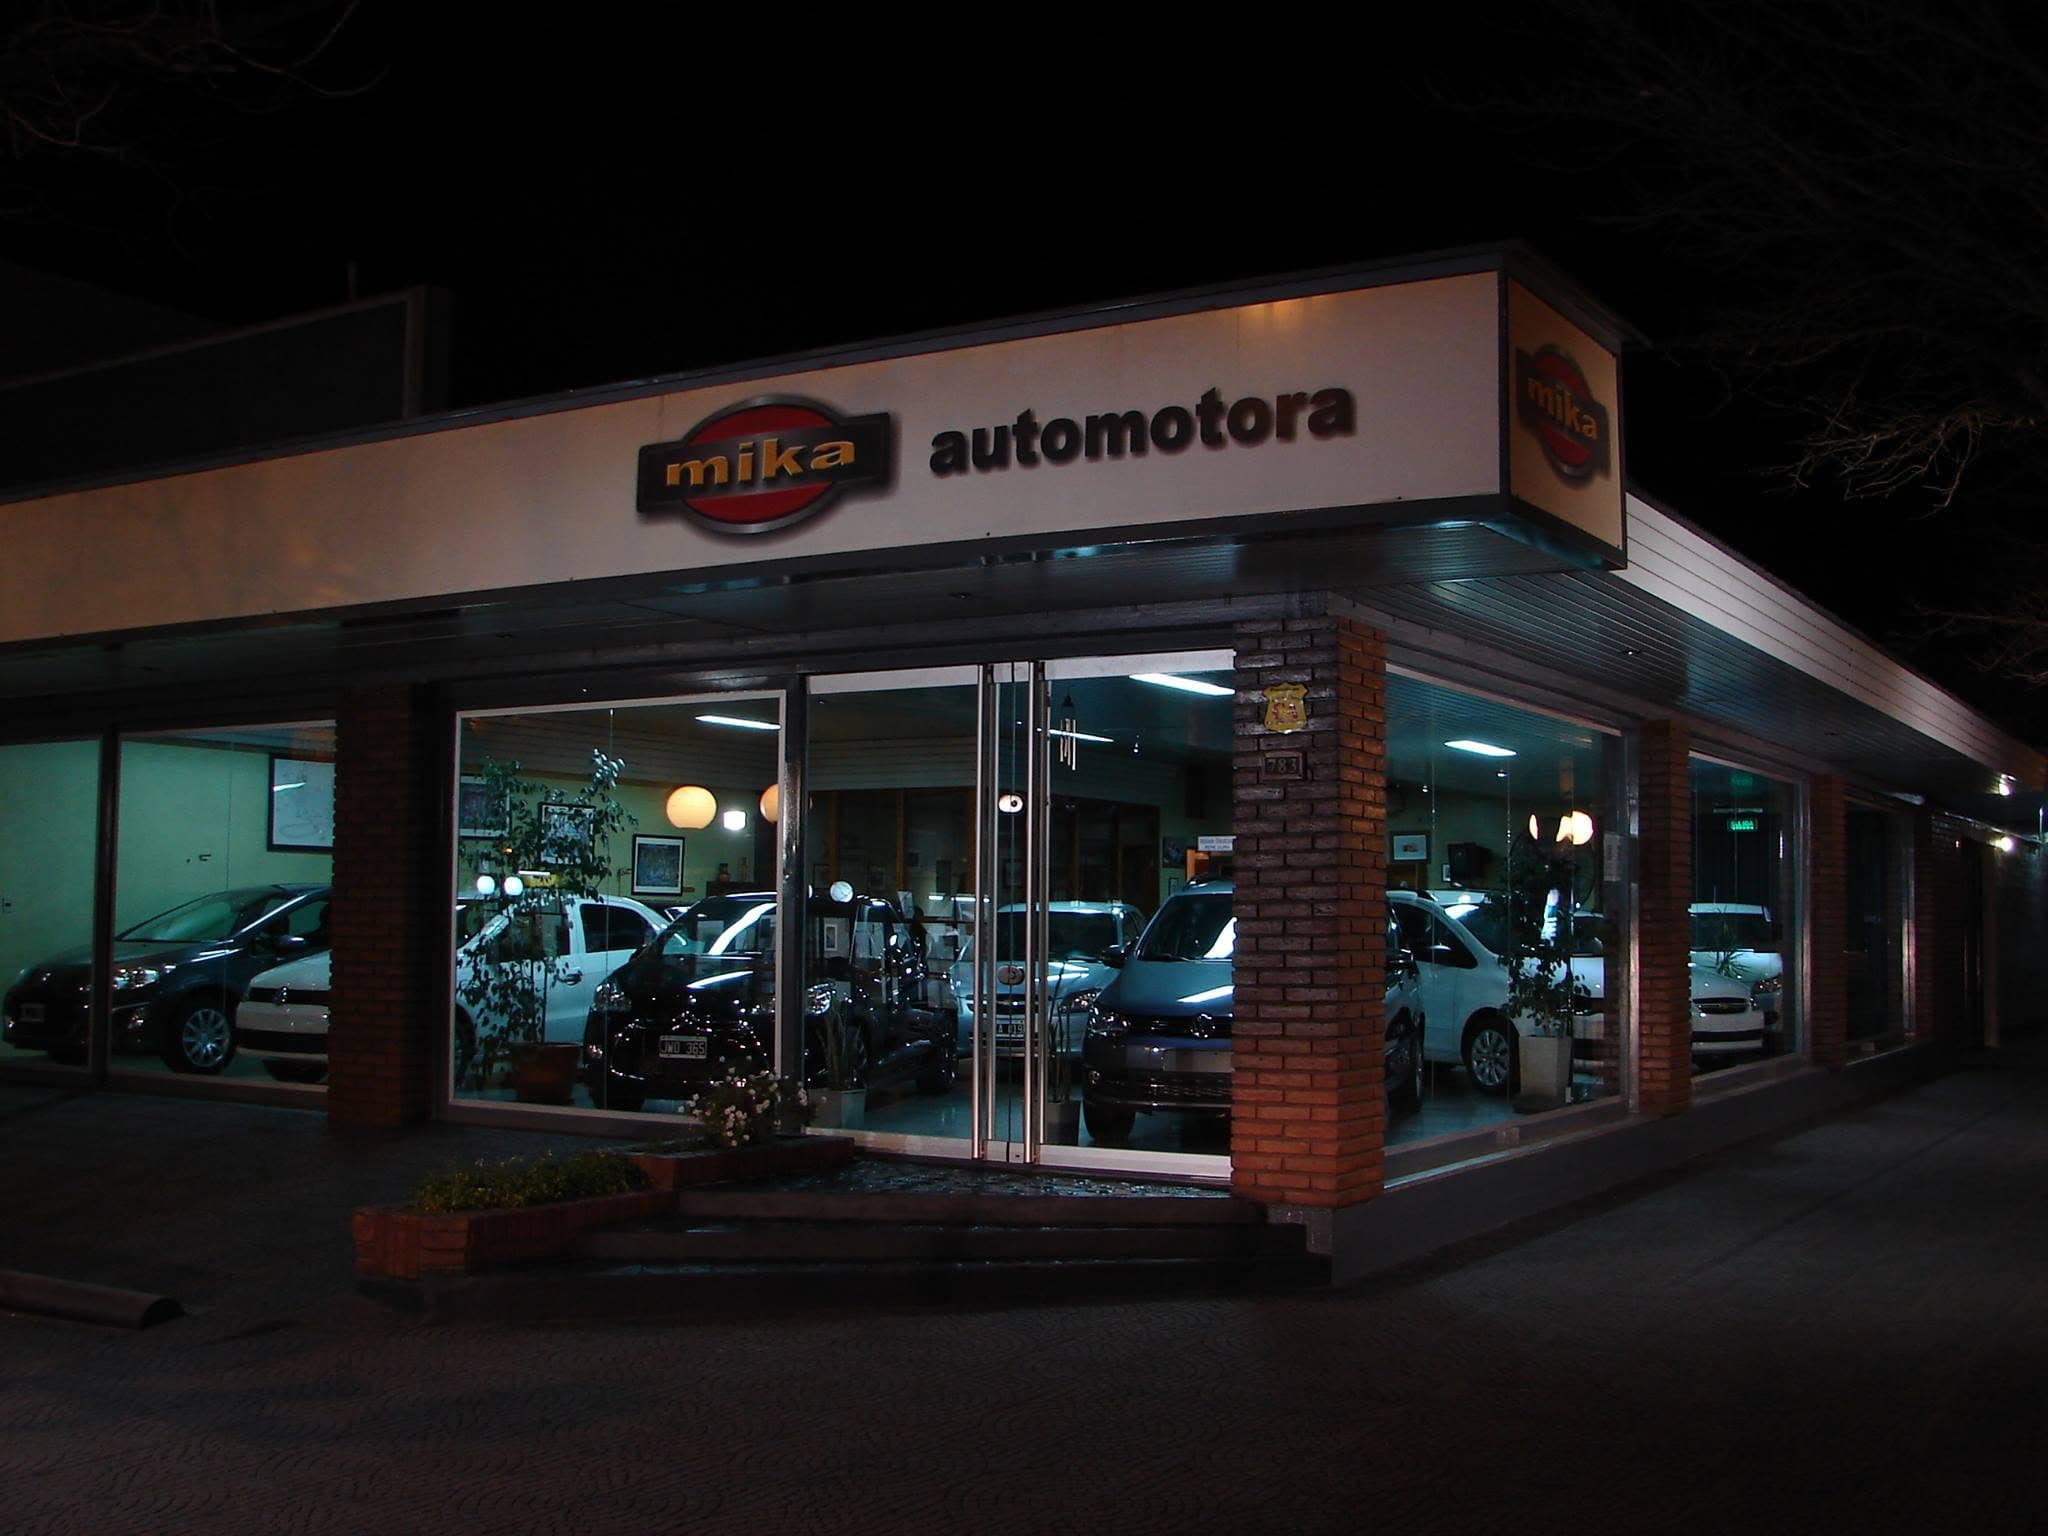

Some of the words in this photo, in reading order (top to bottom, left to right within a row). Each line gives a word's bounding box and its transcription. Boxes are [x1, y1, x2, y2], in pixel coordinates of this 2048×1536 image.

[929, 387, 1357, 475] automotora
[1527, 377, 1600, 440] mika
[666, 438, 856, 487] mika
